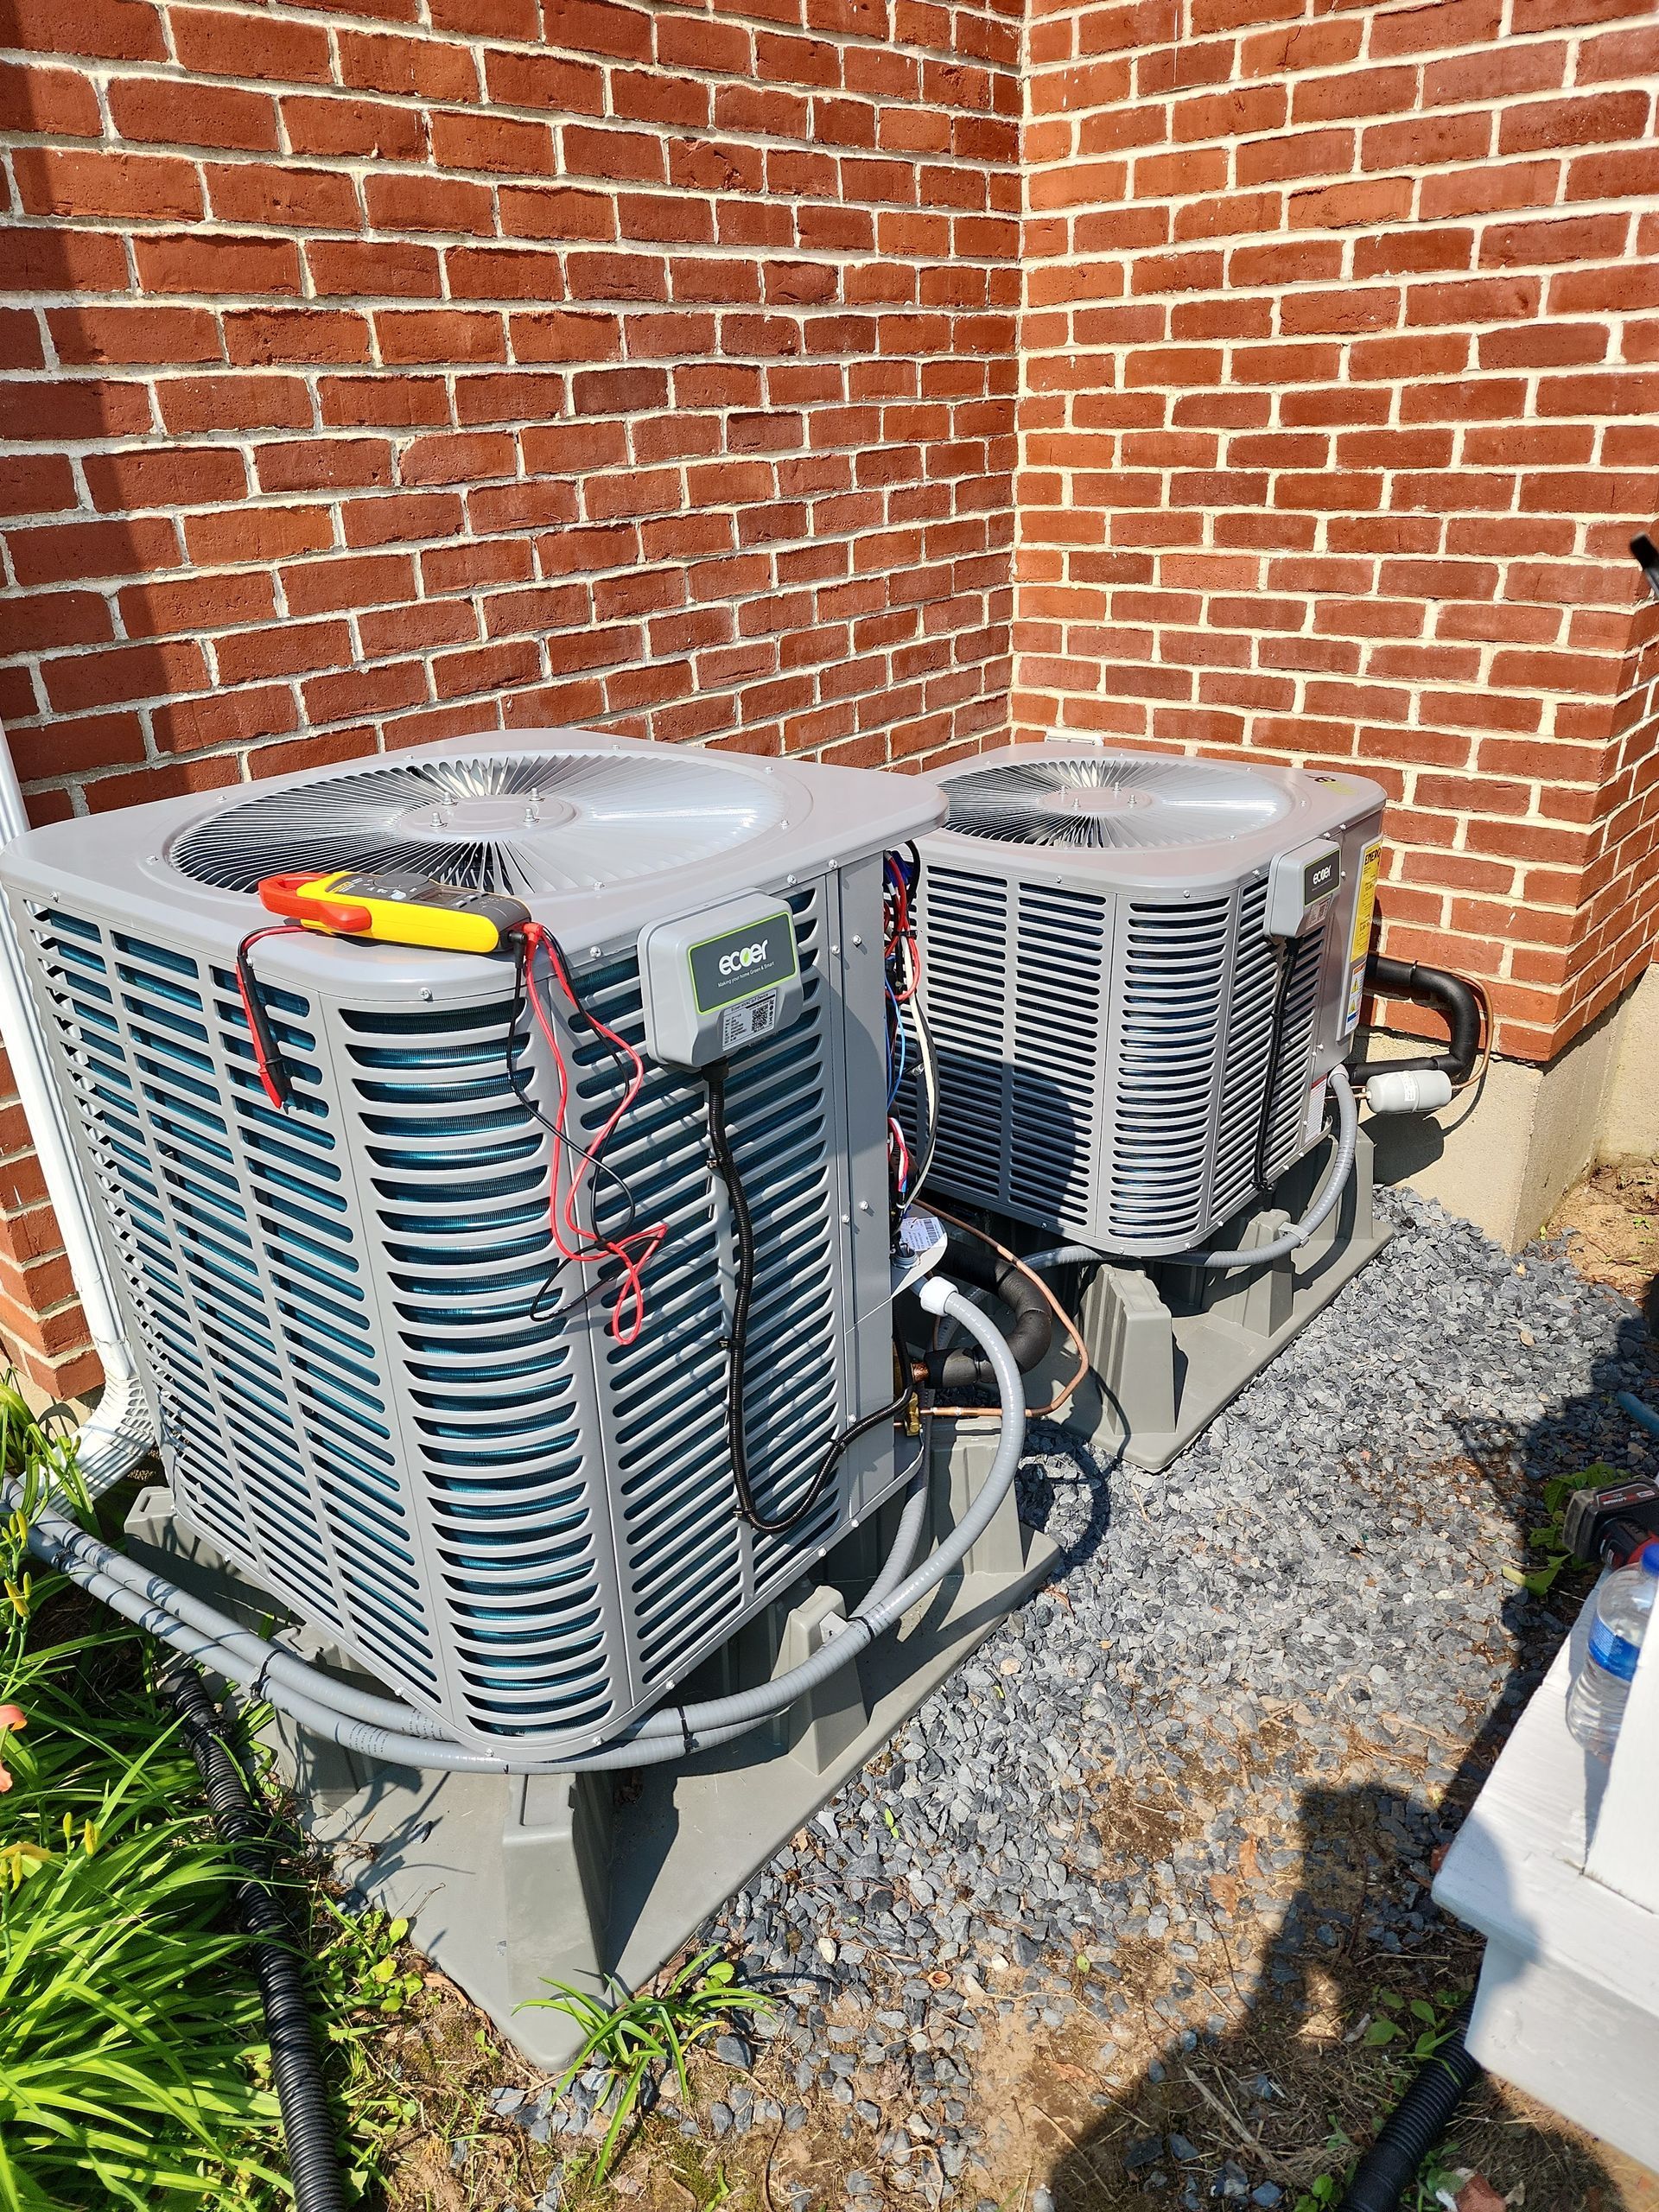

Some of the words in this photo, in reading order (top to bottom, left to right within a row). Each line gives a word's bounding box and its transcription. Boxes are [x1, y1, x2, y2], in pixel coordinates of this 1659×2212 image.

[1313, 865, 1332, 885] ecoer
[719, 939, 768, 976] ecoer
[717, 979, 732, 988] Making
[764, 961, 775, 969] Smart
